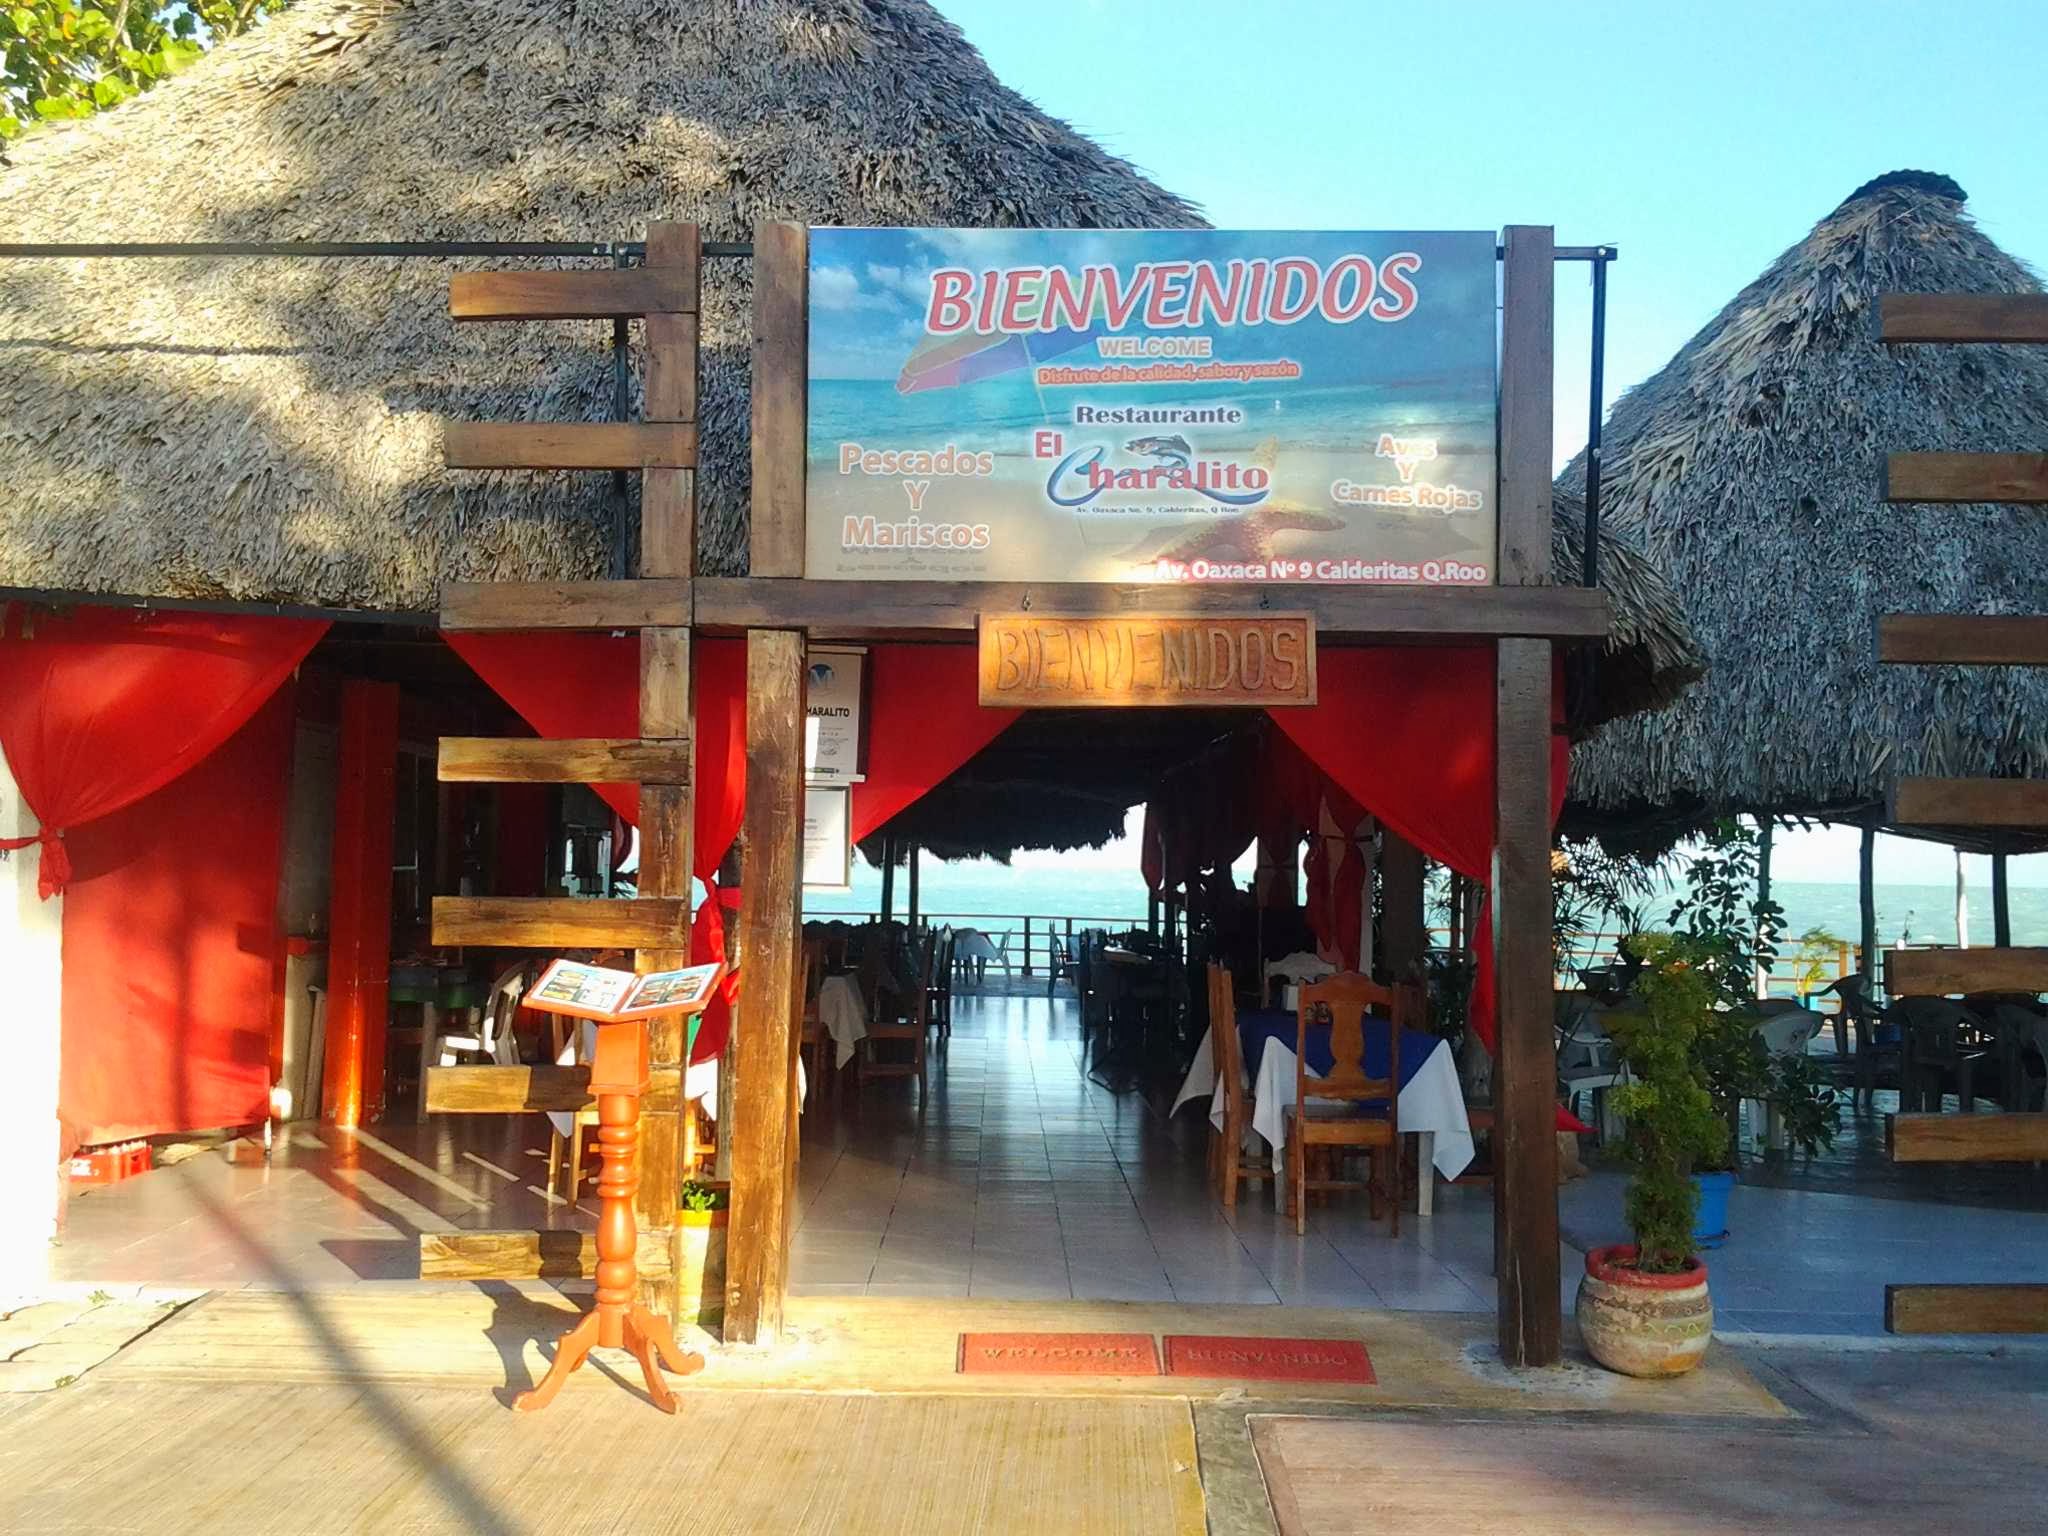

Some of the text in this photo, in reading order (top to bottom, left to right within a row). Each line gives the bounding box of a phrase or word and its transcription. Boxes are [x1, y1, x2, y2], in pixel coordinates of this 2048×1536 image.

[928, 254, 1420, 333] BIENVENIDOS
[1099, 338, 1211, 357] WELCOME
[1038, 367, 1099, 385] Disfrute
[1101, 366, 1121, 383] de
[1121, 365, 1136, 382] la
[1137, 363, 1196, 382] calidad,
[1254, 360, 1298, 378] sazón
[1076, 405, 1242, 425] Restaurante
[1034, 431, 1063, 458] El
[1375, 433, 1438, 461] Aves
[840, 443, 994, 475] Pescados
[1396, 459, 1419, 483] Y
[1046, 445, 1271, 506] Charalito
[903, 480, 930, 511] Y
[1331, 479, 1482, 514] Carnes Rojas
[843, 516, 991, 549] Mariscos
[1157, 560, 1188, 580] Av.
[1191, 560, 1266, 580] Oaxaca
[1299, 560, 1313, 579] 9
[1316, 560, 1419, 580] Calderitas
[1422, 561, 1487, 582] Q.Roo
[997, 627, 1298, 691] BIENVENIDOS
[981, 1346, 1141, 1361] WELCOME
